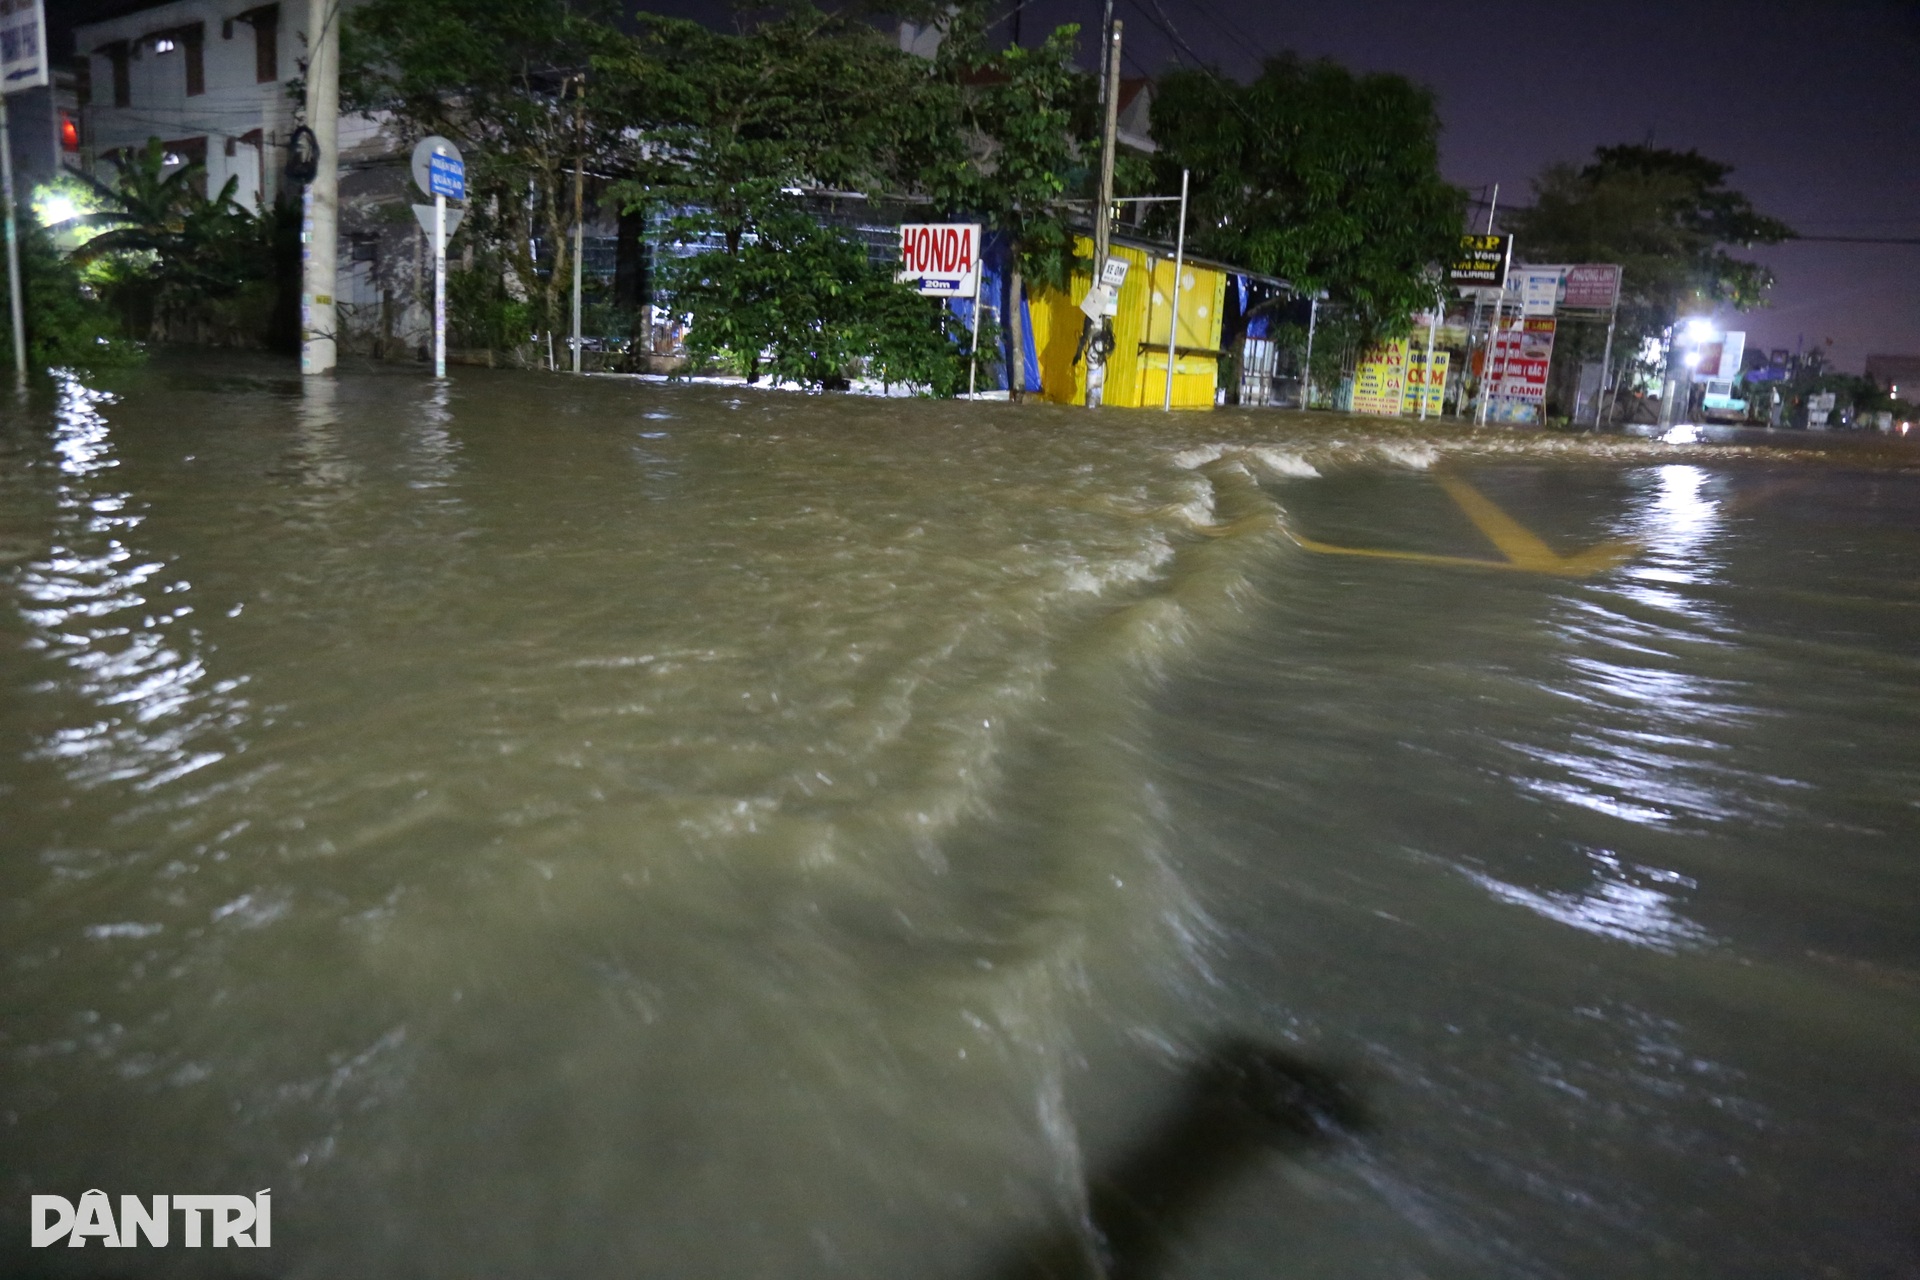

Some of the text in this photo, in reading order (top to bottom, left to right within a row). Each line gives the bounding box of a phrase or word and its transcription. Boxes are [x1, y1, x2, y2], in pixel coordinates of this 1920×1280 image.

[903, 228, 971, 273] HONDA
[1450, 270, 1496, 280] BILLIARDS
[925, 280, 951, 289] 20m
